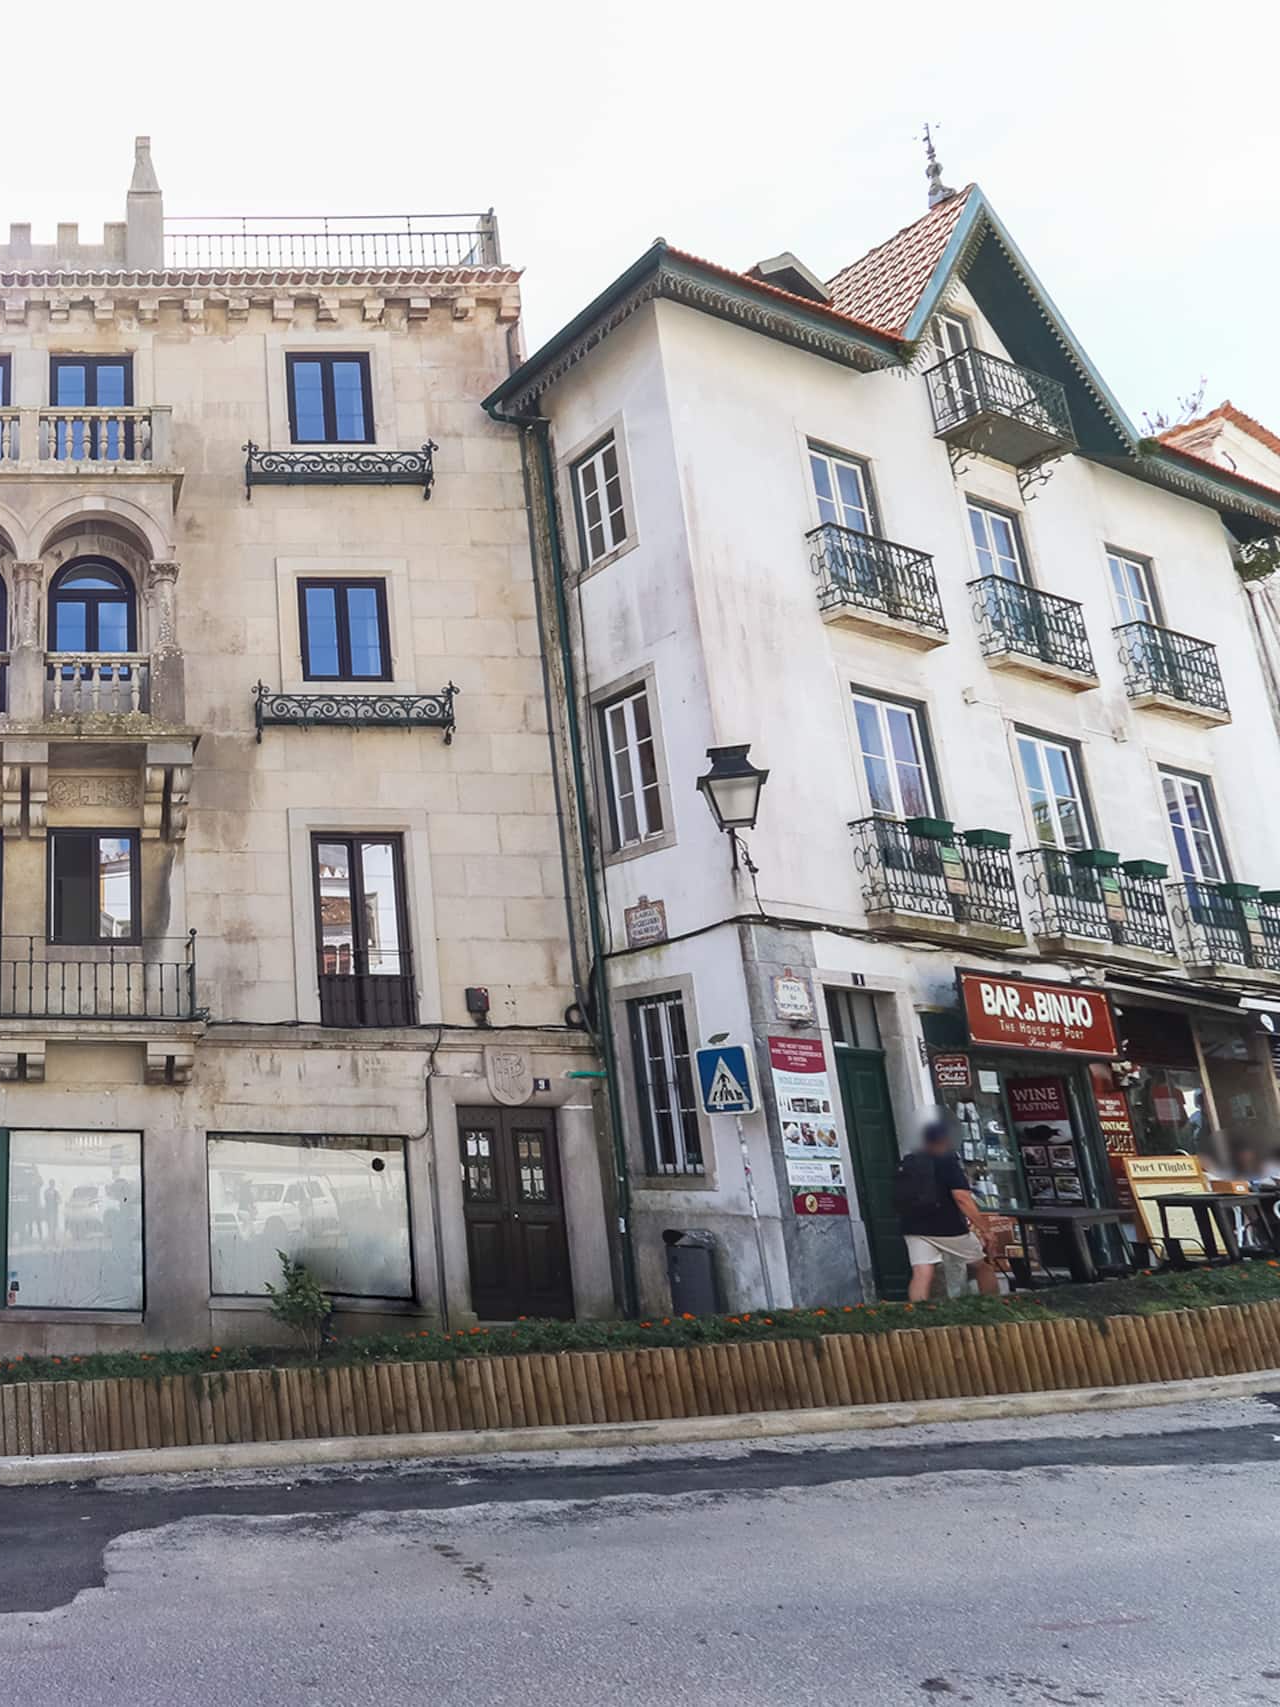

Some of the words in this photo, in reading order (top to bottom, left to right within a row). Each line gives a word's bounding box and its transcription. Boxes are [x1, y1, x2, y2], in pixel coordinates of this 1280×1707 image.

[980, 983, 1024, 1020] BAR
[1033, 991, 1093, 1028] BINHO
[1012, 1087, 1059, 1101] WINE
[1016, 1101, 1060, 1111] TASTING
[1132, 1163, 1154, 1173] Port
[1158, 1161, 1194, 1173] Flights
